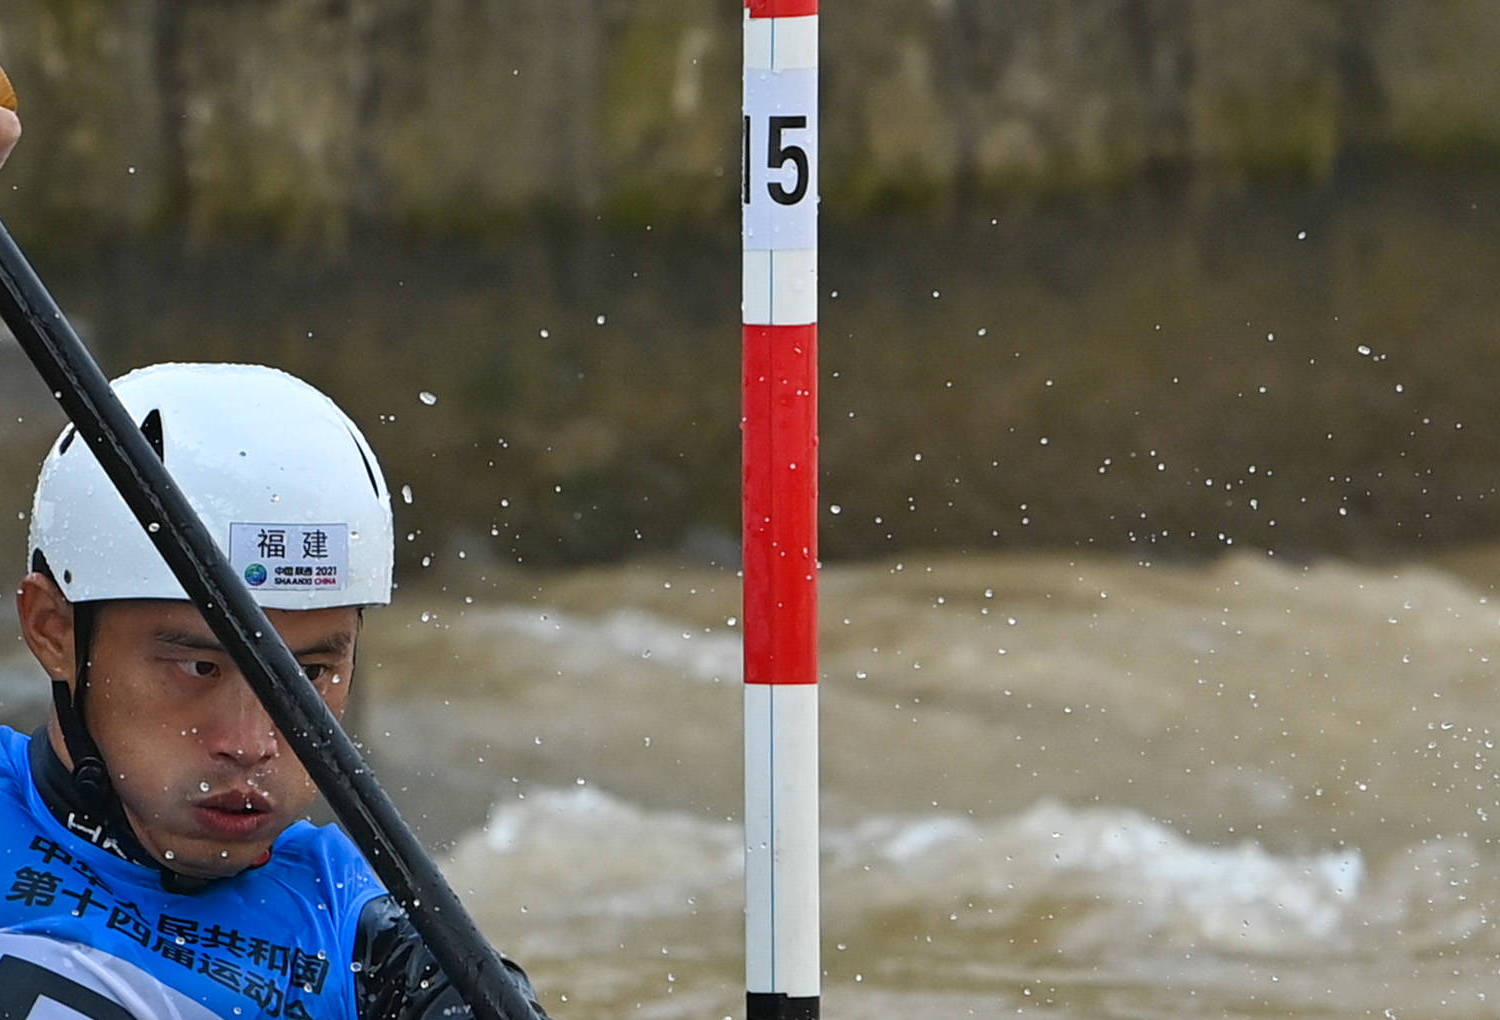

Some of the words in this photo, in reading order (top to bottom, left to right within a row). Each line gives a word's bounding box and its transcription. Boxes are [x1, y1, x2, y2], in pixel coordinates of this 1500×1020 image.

[257, 529, 328, 559] 福建
[315, 566, 337, 576] 2021
[274, 577, 312, 585] SHAANXI
[314, 577, 336, 585] CHINA
